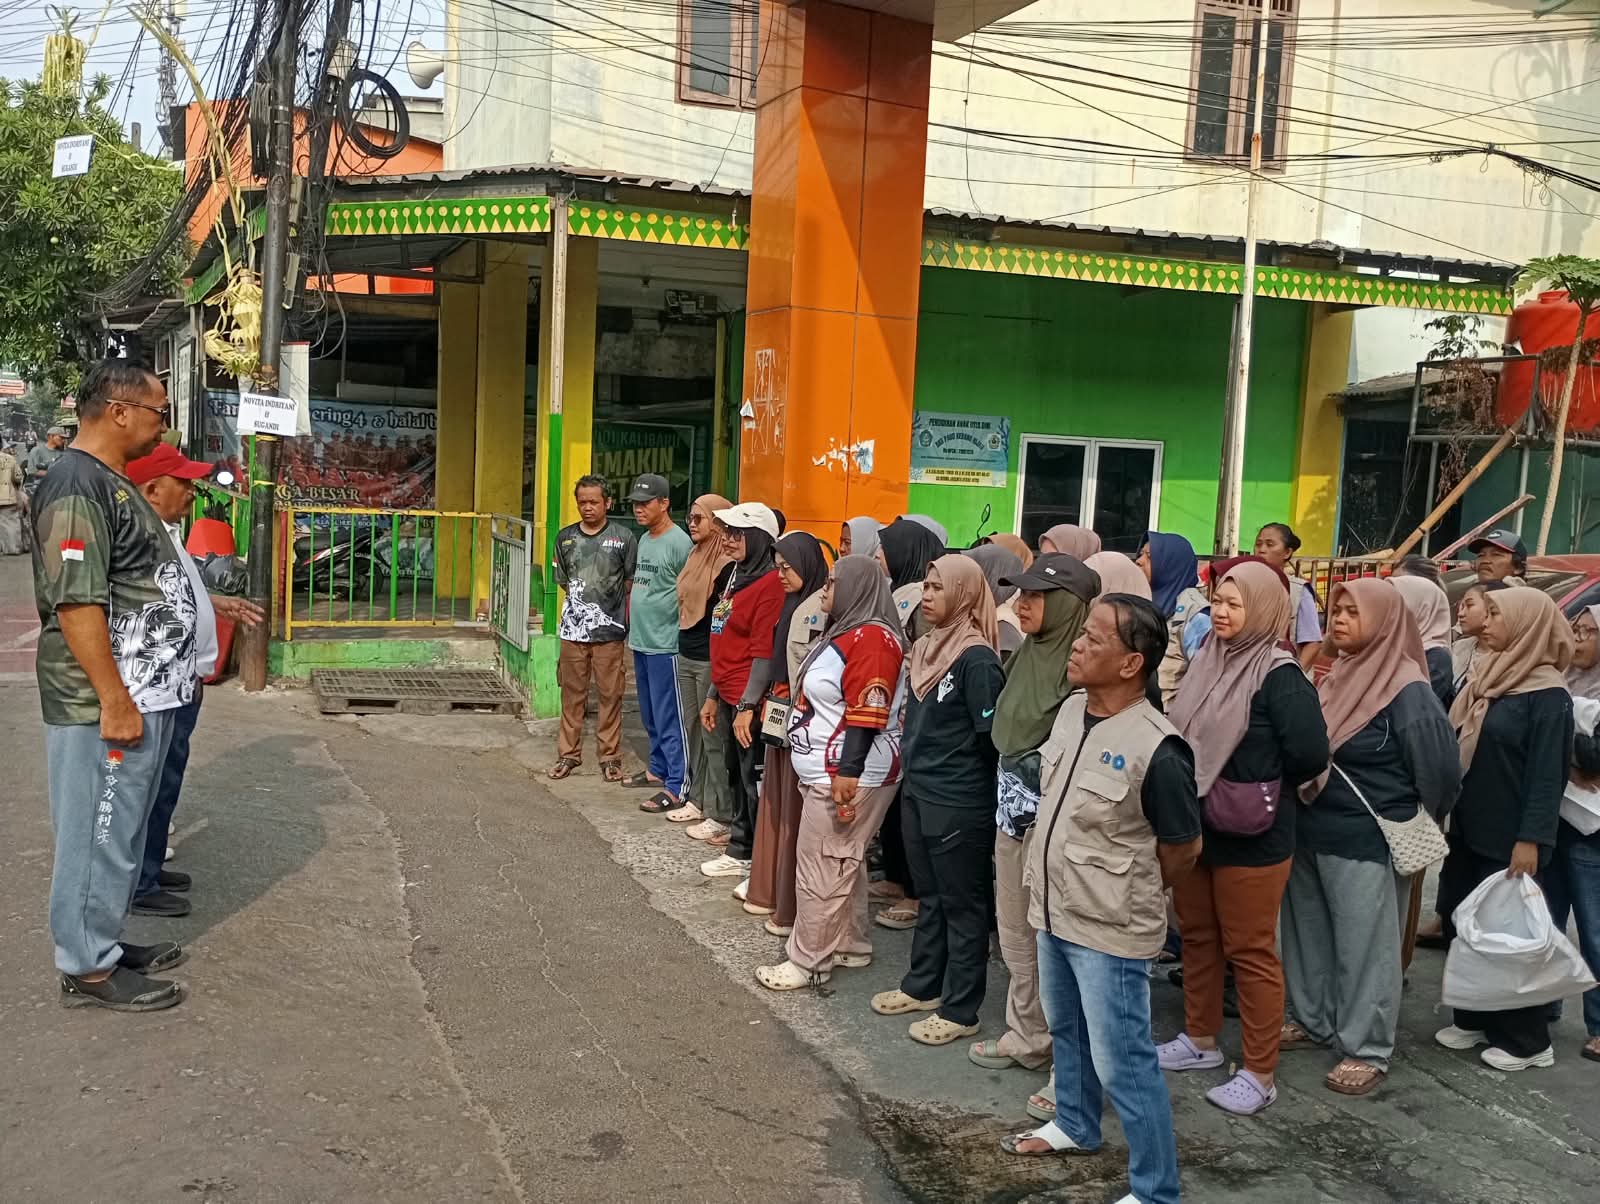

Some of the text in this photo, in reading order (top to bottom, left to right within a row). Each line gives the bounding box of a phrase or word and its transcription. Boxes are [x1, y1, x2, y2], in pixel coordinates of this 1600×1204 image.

[243, 396, 264, 406] NOVITA
[311, 407, 353, 427] ering
[371, 414, 385, 428] &
[254, 420, 280, 431] SUGANDI
[306, 486, 361, 502] BESAR
[602, 539, 625, 549] ARMY
[771, 707, 786, 718] min
[768, 715, 783, 726] min
